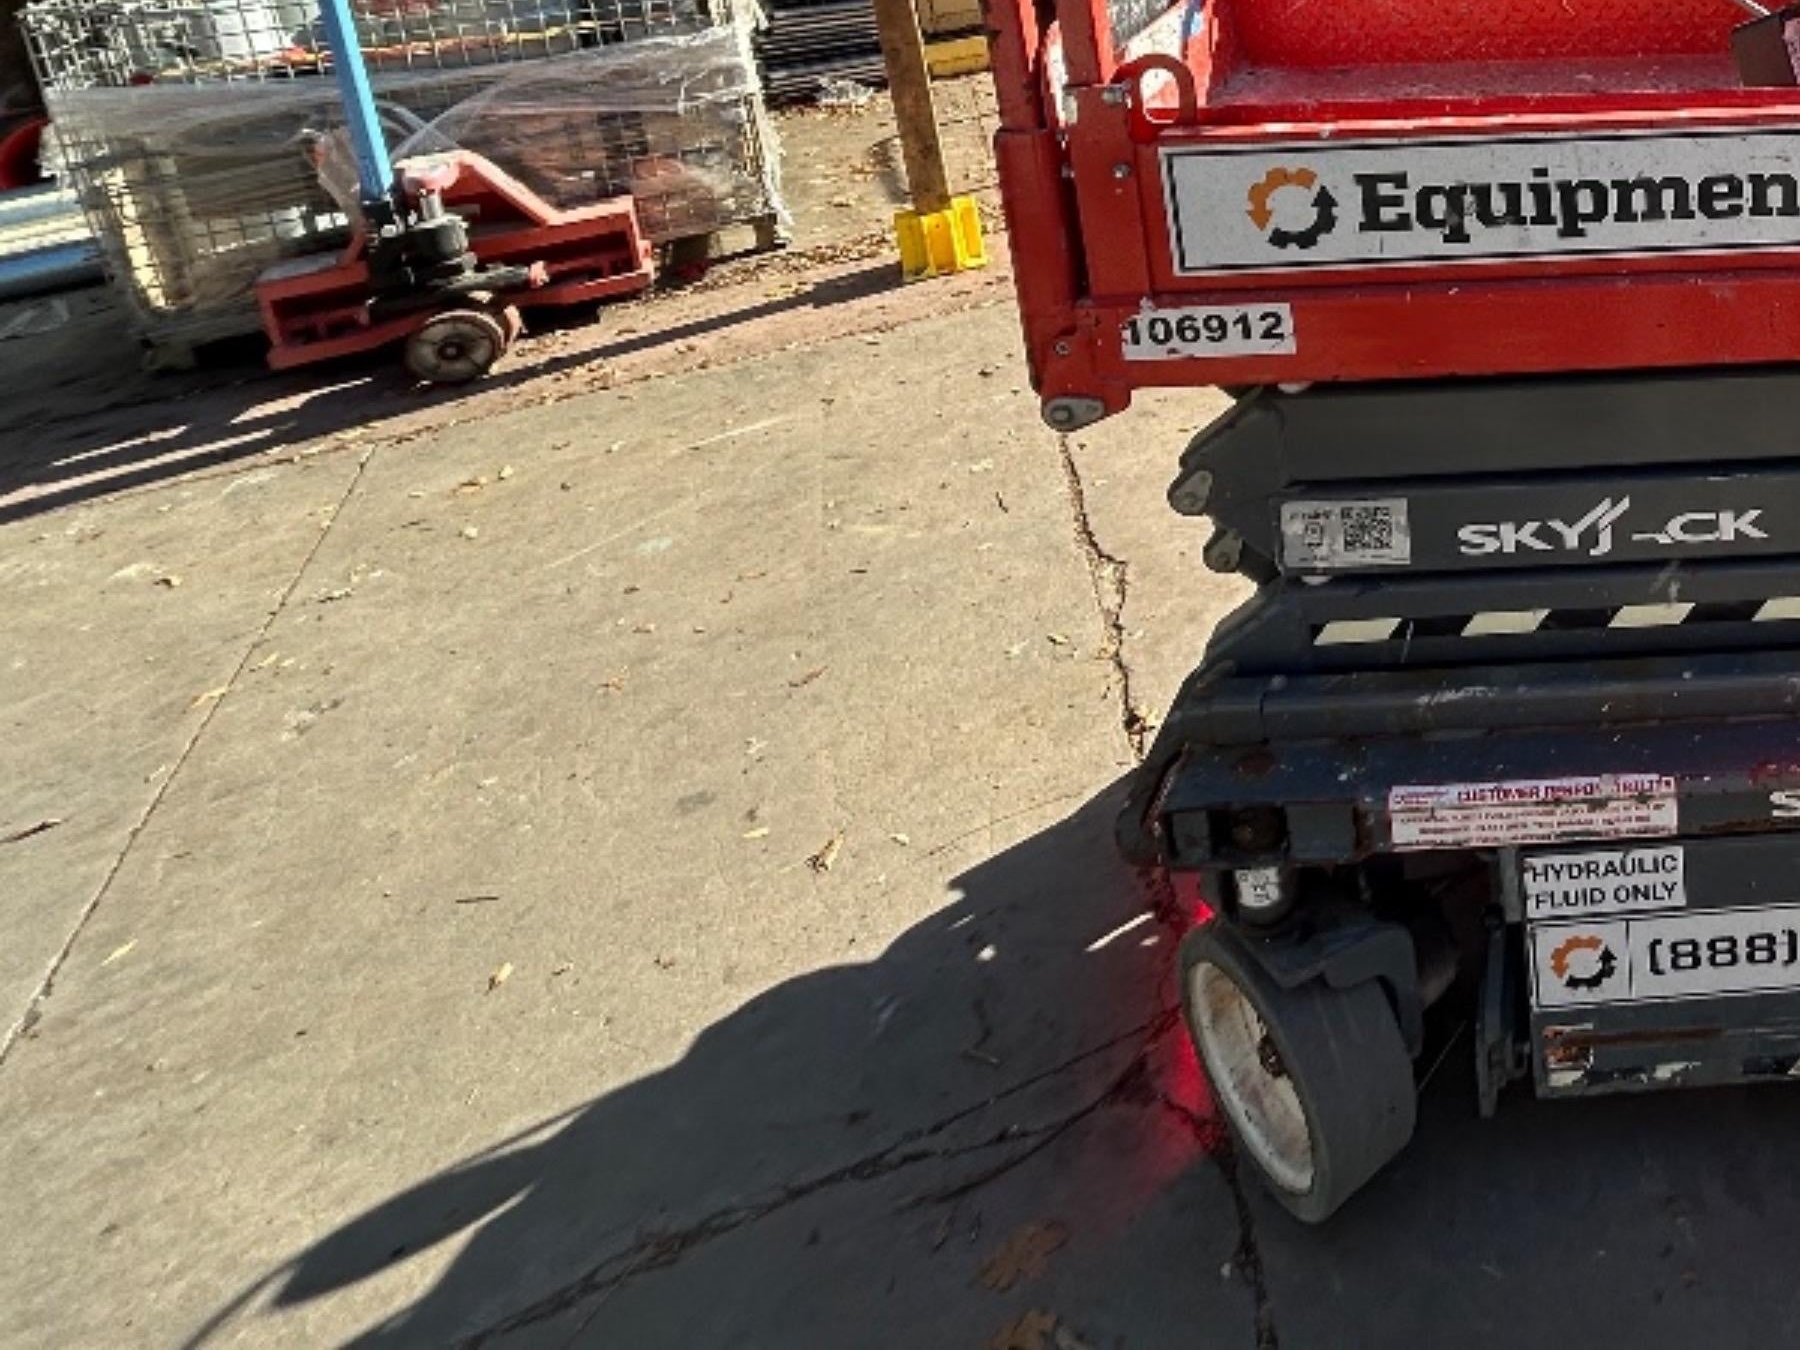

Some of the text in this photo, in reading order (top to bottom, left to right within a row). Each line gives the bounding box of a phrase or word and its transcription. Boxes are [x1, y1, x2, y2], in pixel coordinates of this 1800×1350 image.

[1126, 310, 1286, 346] 106912
[1531, 854, 1678, 883] HYDRAULIC
[1534, 880, 1678, 910] FLUID ONLY
